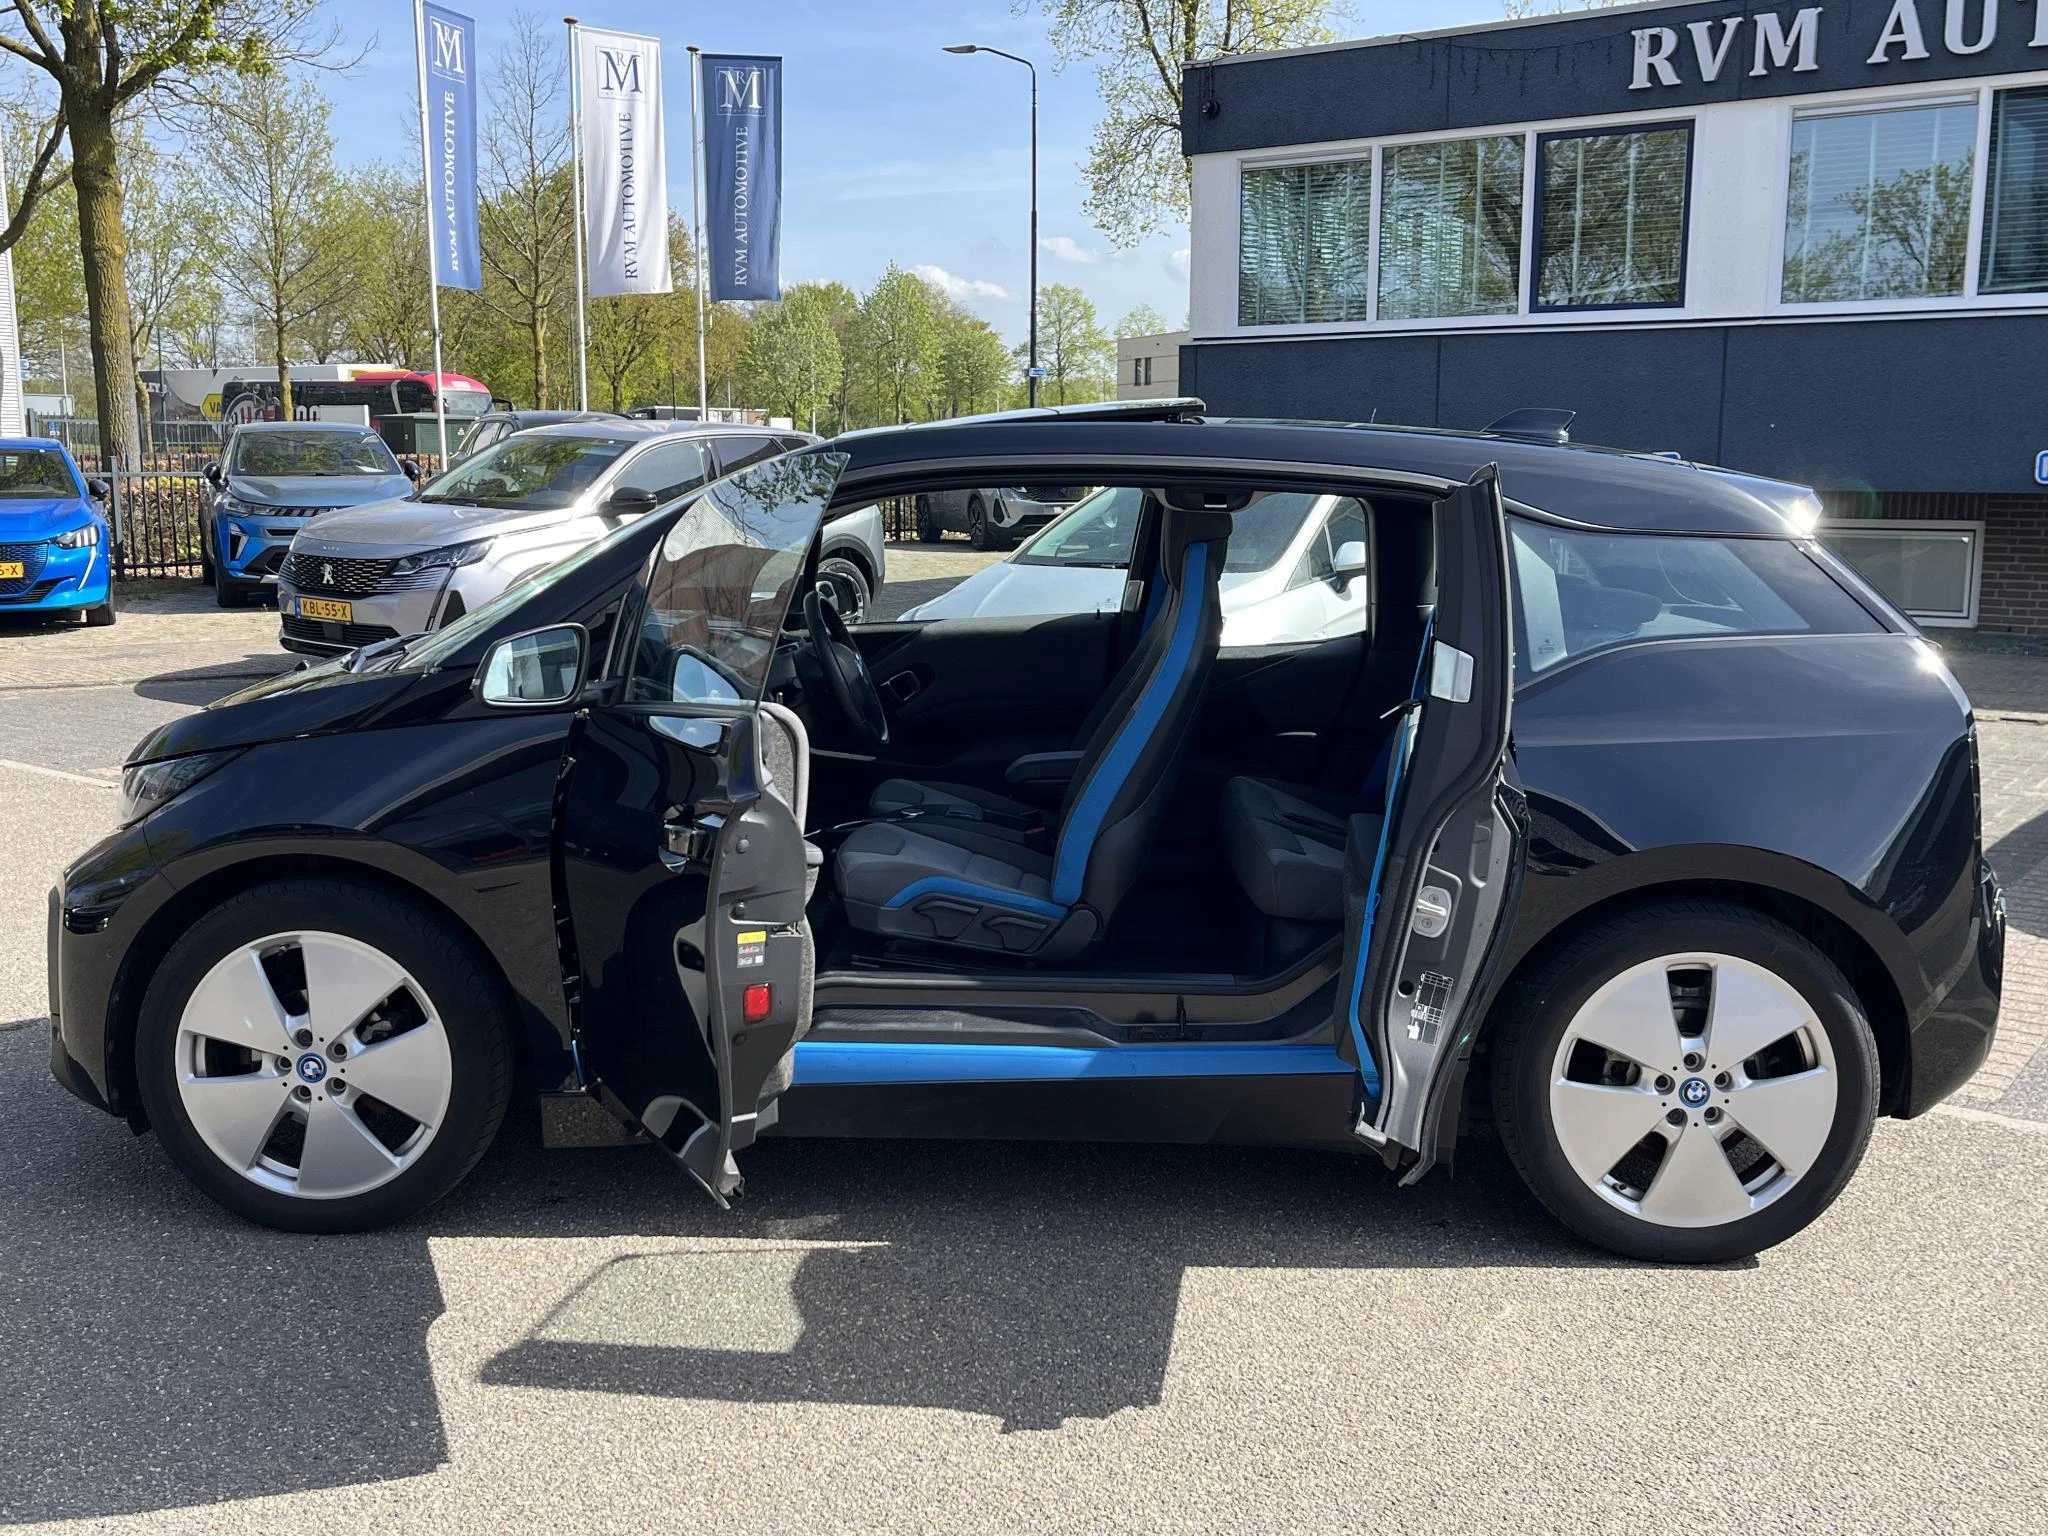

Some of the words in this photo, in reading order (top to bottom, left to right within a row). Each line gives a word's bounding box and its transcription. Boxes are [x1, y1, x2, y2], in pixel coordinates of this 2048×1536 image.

[1628, 7, 1823, 90] RVM
[1866, 0, 2048, 65] AU
[444, 90, 456, 226] AUTOMOTIVE
[618, 112, 636, 235] AUTOMOTIVE
[735, 126, 748, 244] AUTOMOTIVE
[449, 228, 459, 272] RVM
[624, 241, 638, 279] RVM
[735, 248, 748, 287] RVM
[302, 600, 348, 618] KBL-55-X
